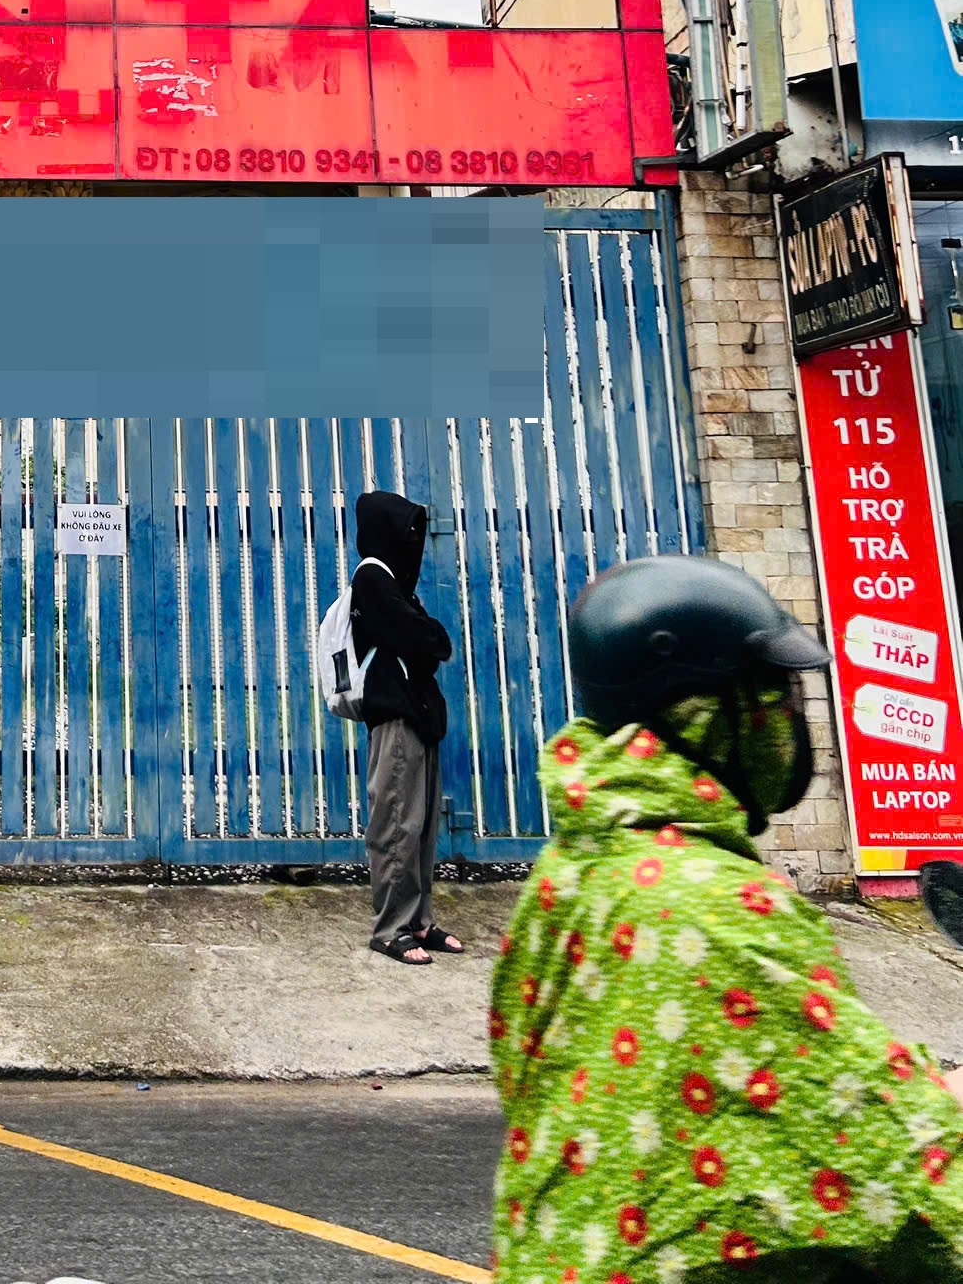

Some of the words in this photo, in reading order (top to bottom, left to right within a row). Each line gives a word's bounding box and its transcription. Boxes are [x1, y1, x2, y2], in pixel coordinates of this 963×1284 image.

[239, 148, 306, 174] 3810
[315, 148, 381, 174] 9341
[405, 149, 443, 175] 08
[450, 149, 519, 176] 3810
[831, 360, 882, 398] TỬ
[833, 417, 896, 445] 115
[848, 462, 891, 490] HỖ
[72, 510, 87, 519] VUI
[89, 510, 111, 519] LÒNG
[841, 498, 904, 527] TRỢ
[61, 522, 90, 531] KHÔNG
[113, 523, 123, 531] XE
[87, 534, 105, 543] ĐÂY
[848, 533, 910, 561] TRẢ
[852, 571, 916, 600] GÓP
[872, 642, 930, 669] THẤP
[883, 703, 935, 728] CCCD
[906, 728, 932, 743] chip
[861, 763, 910, 781] MUA
[913, 760, 956, 781] BÁN
[872, 790, 951, 809] LAPTOP
